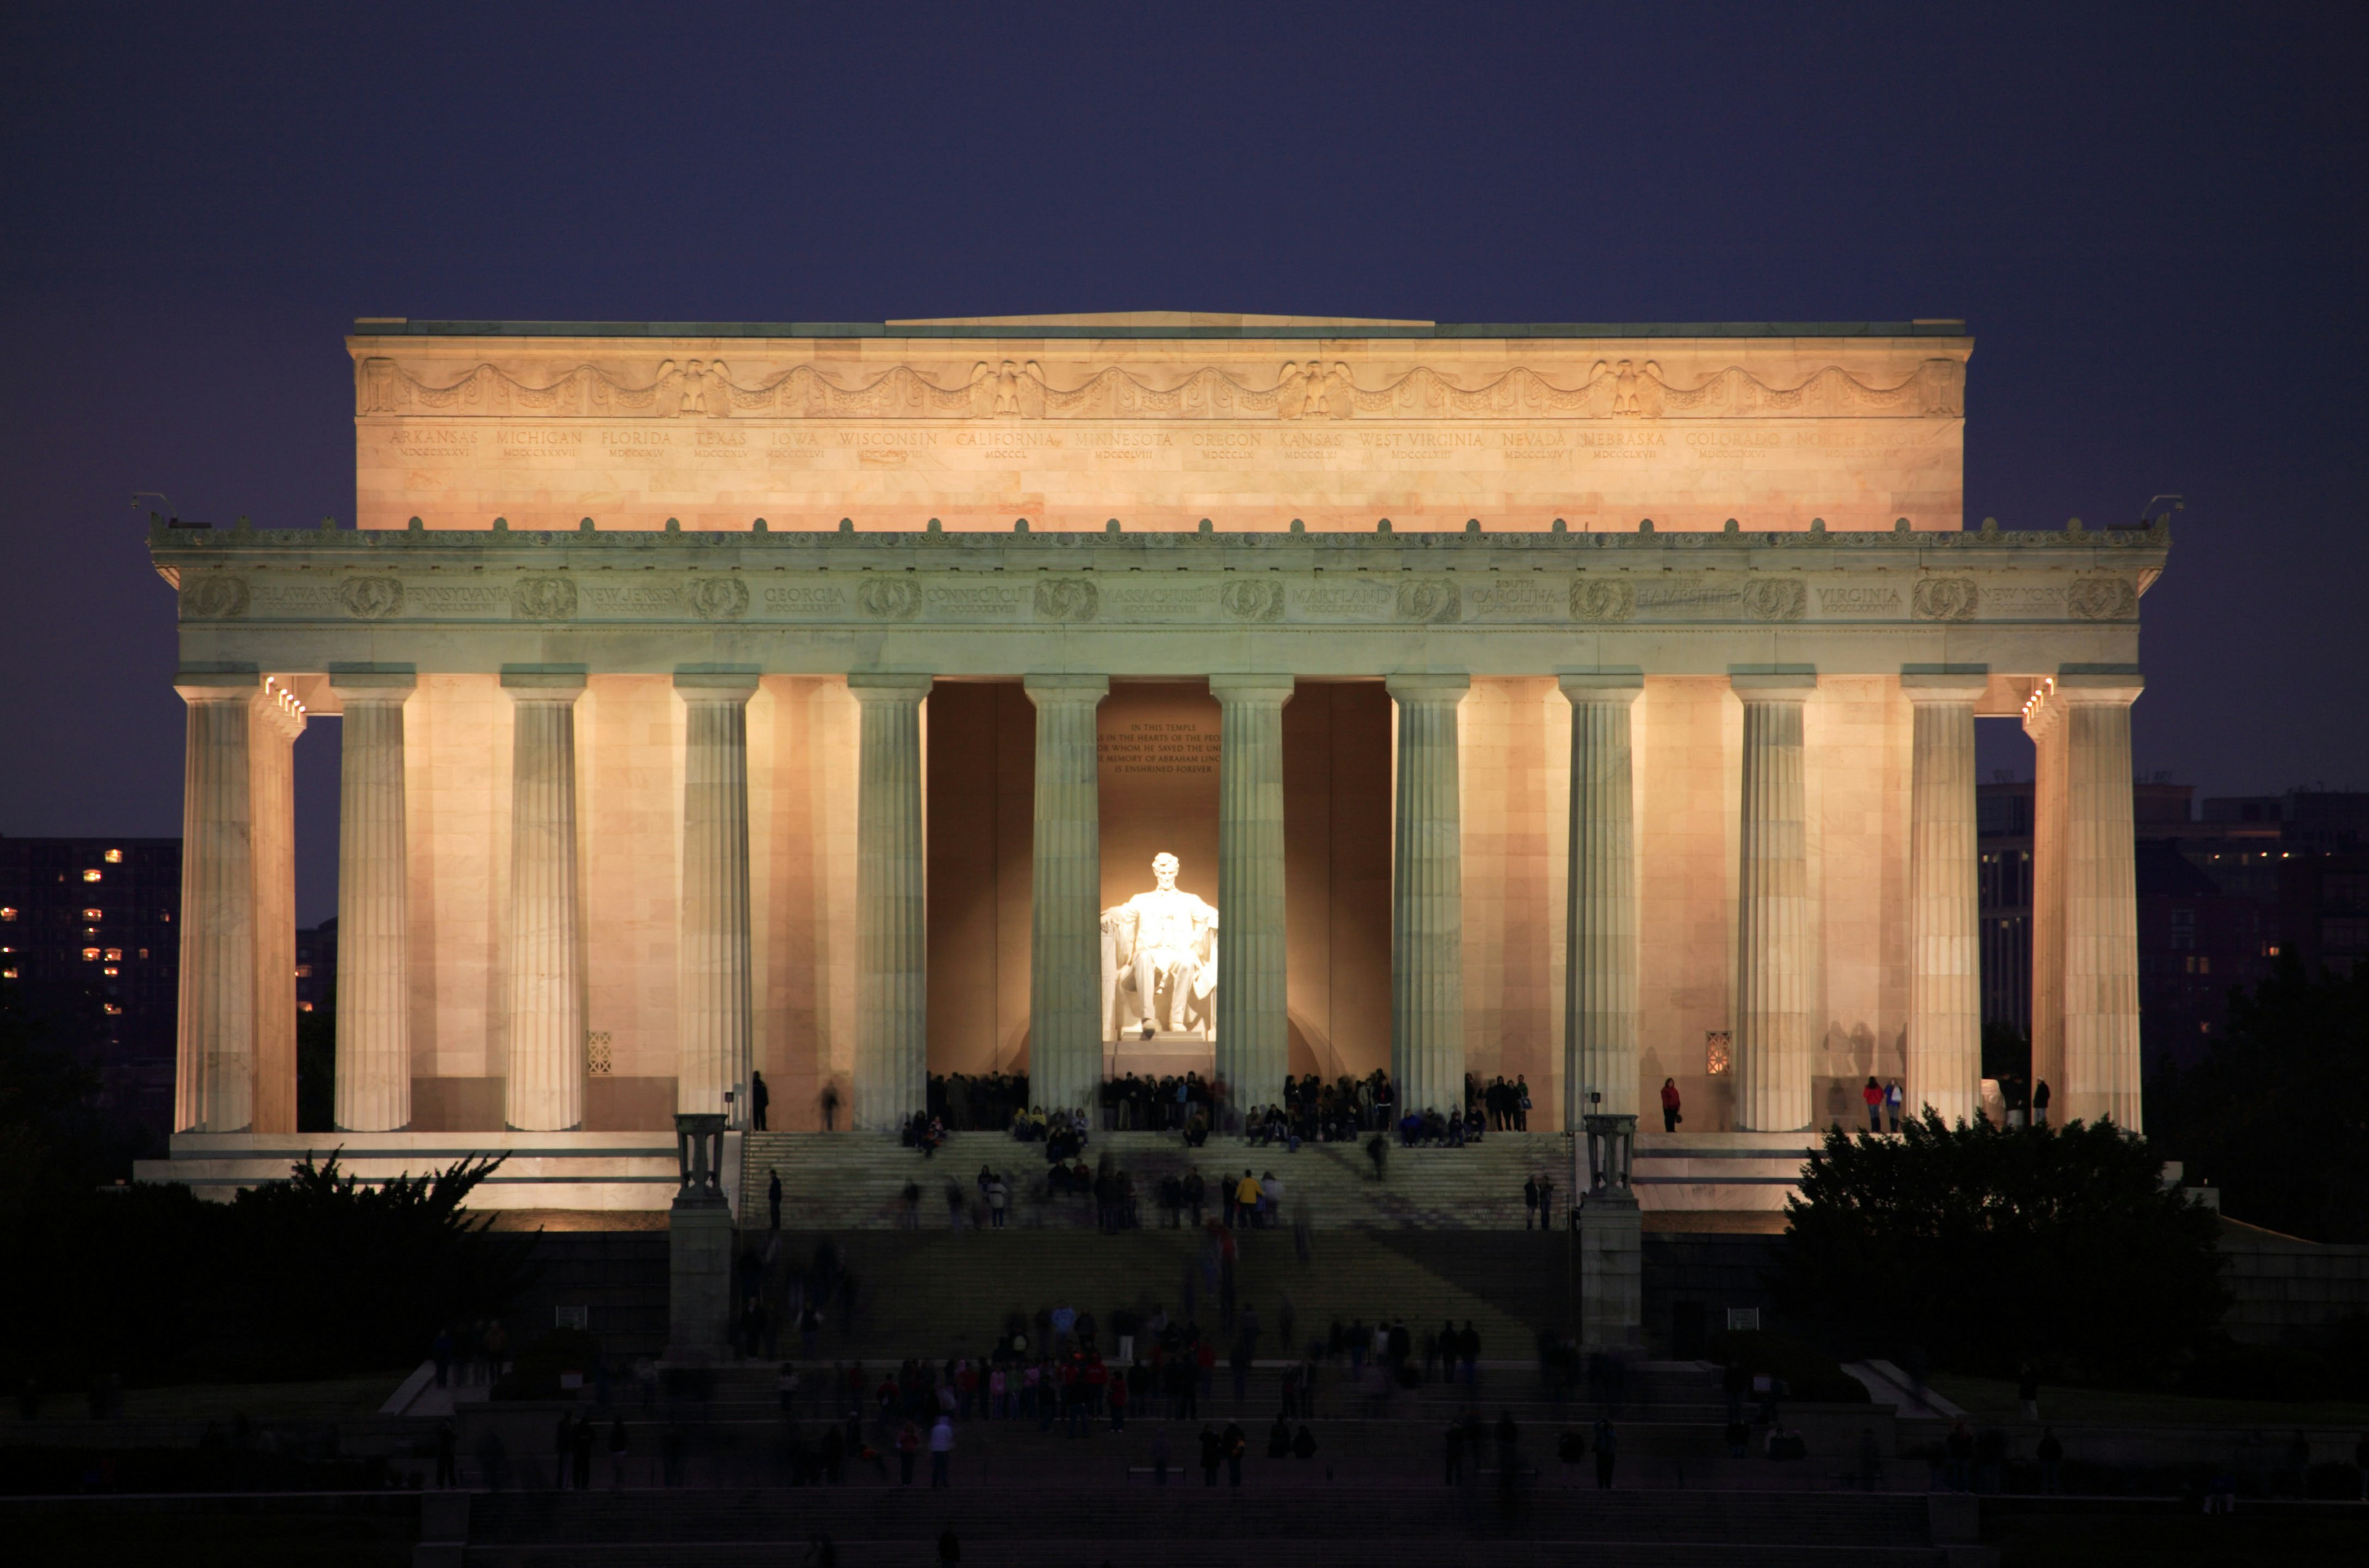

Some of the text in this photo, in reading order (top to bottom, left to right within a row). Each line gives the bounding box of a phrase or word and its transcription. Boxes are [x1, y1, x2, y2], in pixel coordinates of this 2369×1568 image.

[389, 431, 478, 444] ARKANSAS
[496, 431, 582, 444] MICHIGAN
[602, 432, 672, 445] FLORIDA
[695, 432, 746, 445] TEXAS
[772, 432, 818, 445] IOWA
[839, 432, 937, 445] WISCONSIN
[956, 433, 1056, 445] CALIFORNIA
[1076, 433, 1173, 445] MINNESOTA
[1192, 433, 1262, 446] OREGON
[1280, 433, 1342, 446] KANSAS
[1359, 433, 1484, 446] WEST VIRGINIA
[1502, 432, 1566, 446] NEVADA
[1584, 432, 1667, 446] NEBRASKA
[1686, 432, 1780, 445] COLORADO
[1796, 432, 1856, 445] NORTH
[986, 450, 1027, 458] MDCCCL
[1495, 579, 1535, 588] SOUTH
[1674, 579, 1703, 588] NEW
[249, 587, 339, 601] DELAWARE
[405, 587, 511, 602] PENNSYLVANIA
[582, 587, 680, 602] NEW JERSEY
[764, 588, 846, 603] GEORGIA
[927, 586, 1032, 603] CONNECTICUT
[1292, 589, 1391, 603] MARYLAND
[1471, 589, 1557, 603] CAROLINA
[1817, 588, 1902, 603] VIRGINIA
[1980, 588, 2070, 602] NEW YORK
[1167, 724, 1197, 732] TEMPLE
[1107, 754, 1143, 762] MEMORY
[1145, 754, 1156, 762] OF
[1158, 754, 1198, 762] ABRAHAM
